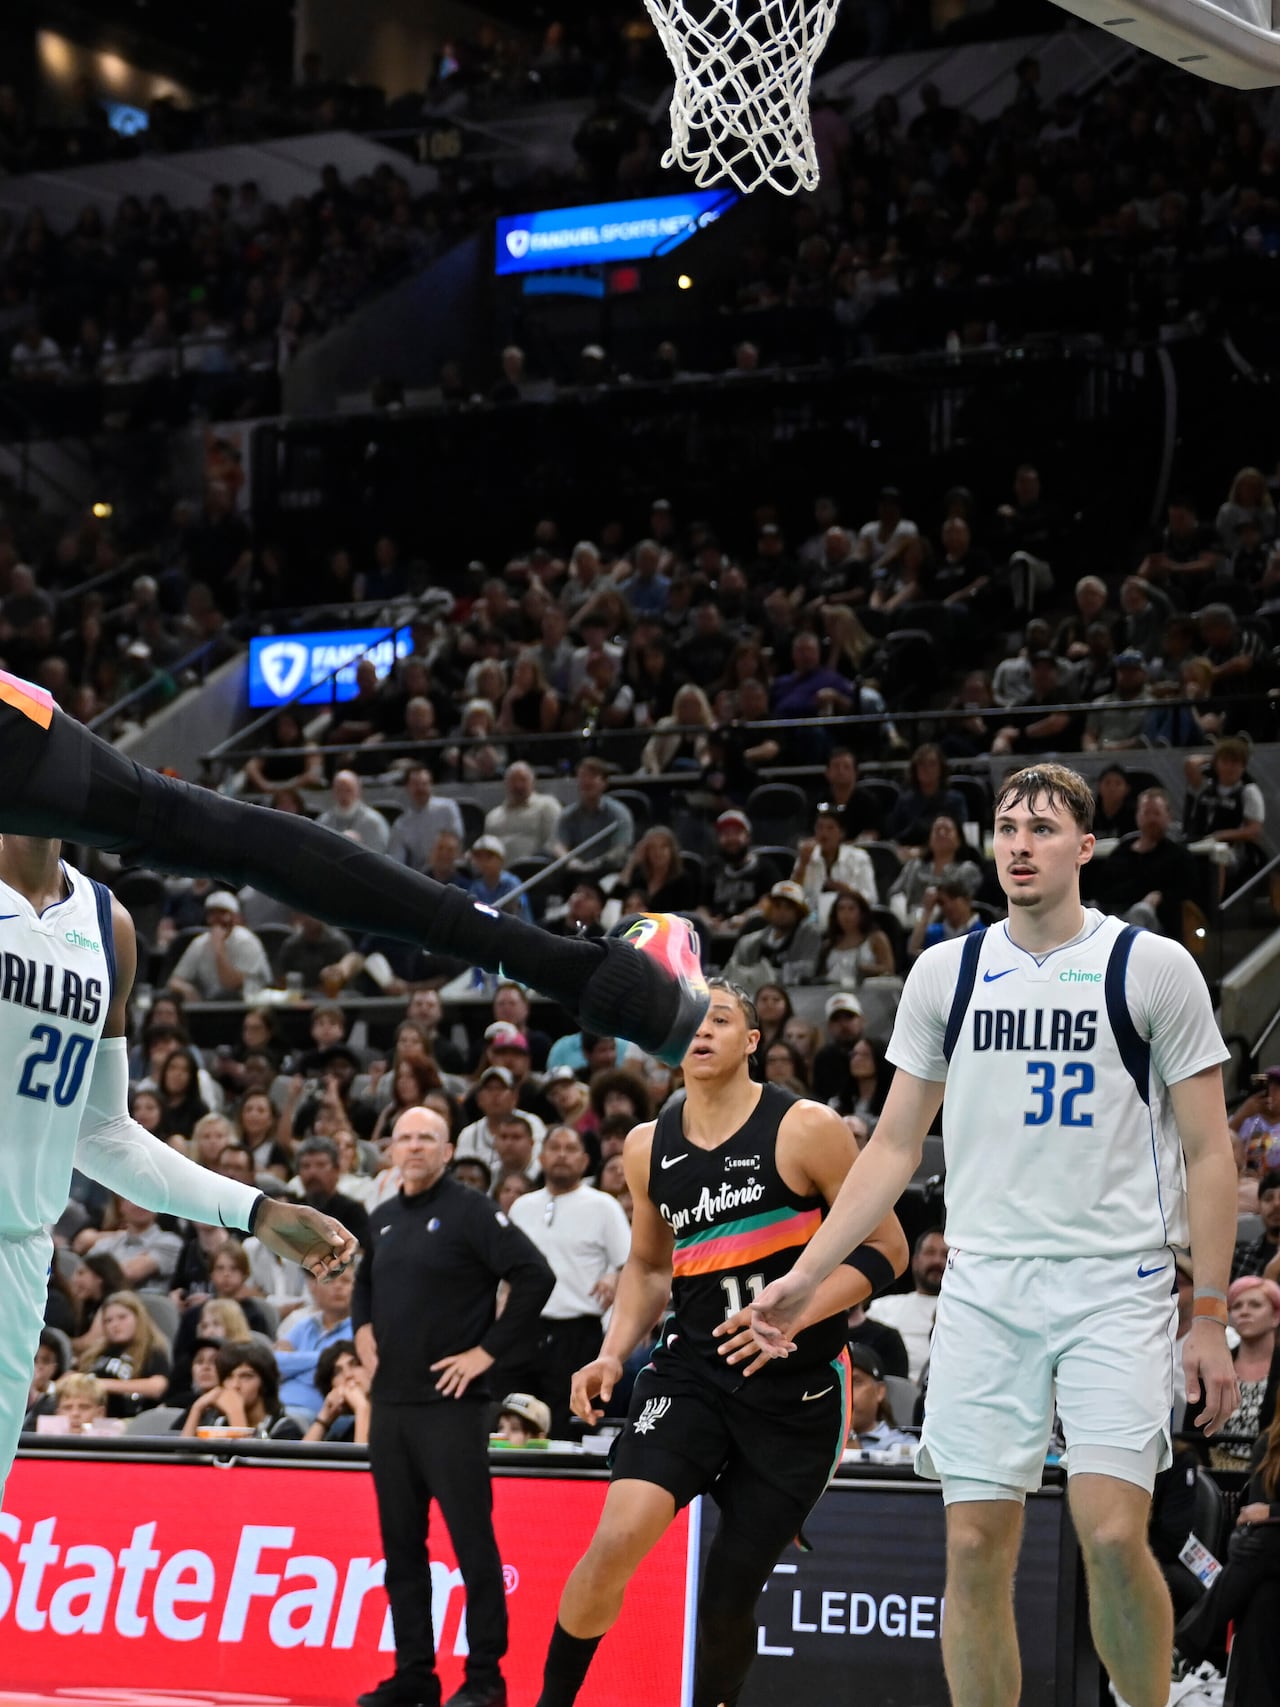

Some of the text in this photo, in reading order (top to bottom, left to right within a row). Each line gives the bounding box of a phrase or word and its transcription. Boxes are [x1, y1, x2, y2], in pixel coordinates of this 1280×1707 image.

[65, 929, 100, 952] chime
[1059, 969, 1102, 983] chime
[973, 1009, 1099, 1053] DALLAS
[17, 1023, 94, 1107] 20
[1023, 1060, 1096, 1128] 32
[728, 1157, 757, 1168] LEDGER
[691, 1177, 765, 1223] Antonio
[792, 1589, 944, 1639] LEDGE
